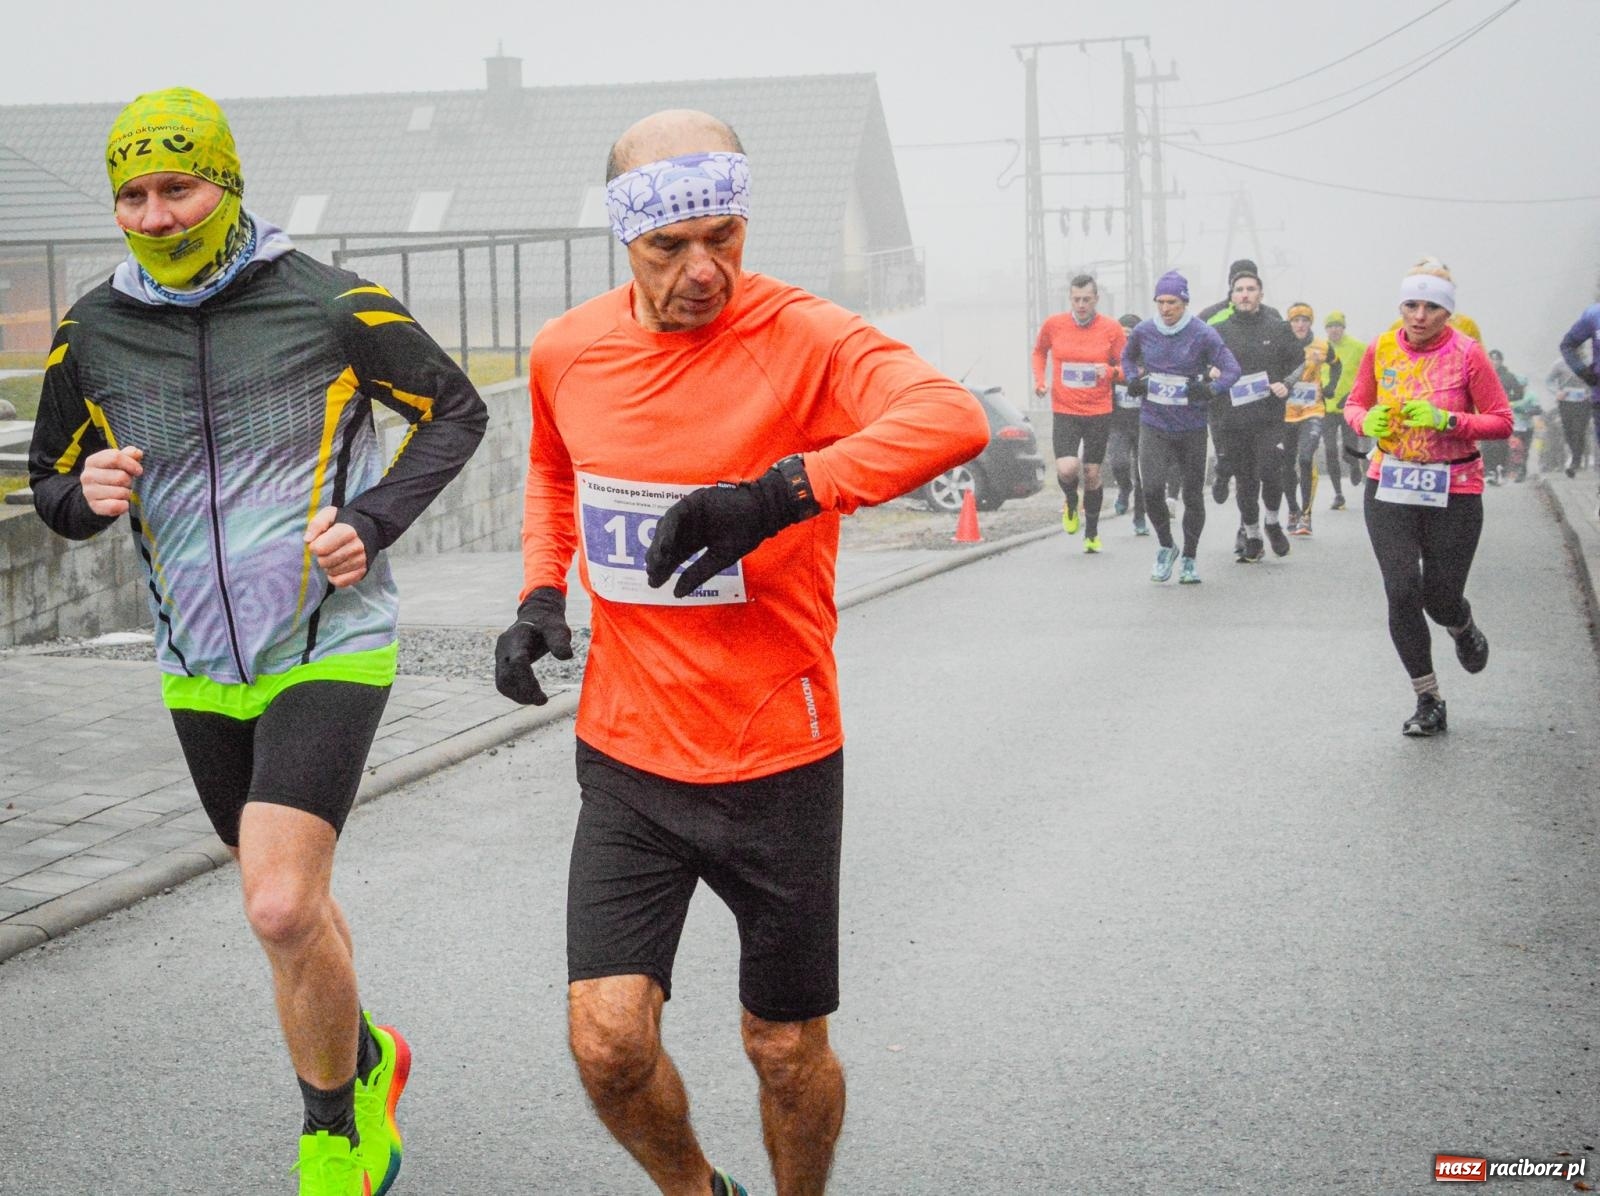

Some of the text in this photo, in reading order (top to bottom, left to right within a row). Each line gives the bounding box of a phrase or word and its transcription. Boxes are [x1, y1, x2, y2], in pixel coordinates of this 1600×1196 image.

[108, 138, 152, 174] XYZ
[1075, 370, 1083, 381] 3
[1158, 384, 1176, 398] 29
[1246, 384, 1254, 396] 1
[1392, 468, 1436, 491] 148
[593, 484, 606, 492] Eko
[606, 486, 629, 495] Cross
[630, 490, 640, 498] po
[641, 490, 665, 499] Ziemi
[801, 677, 819, 737] SALOMON
